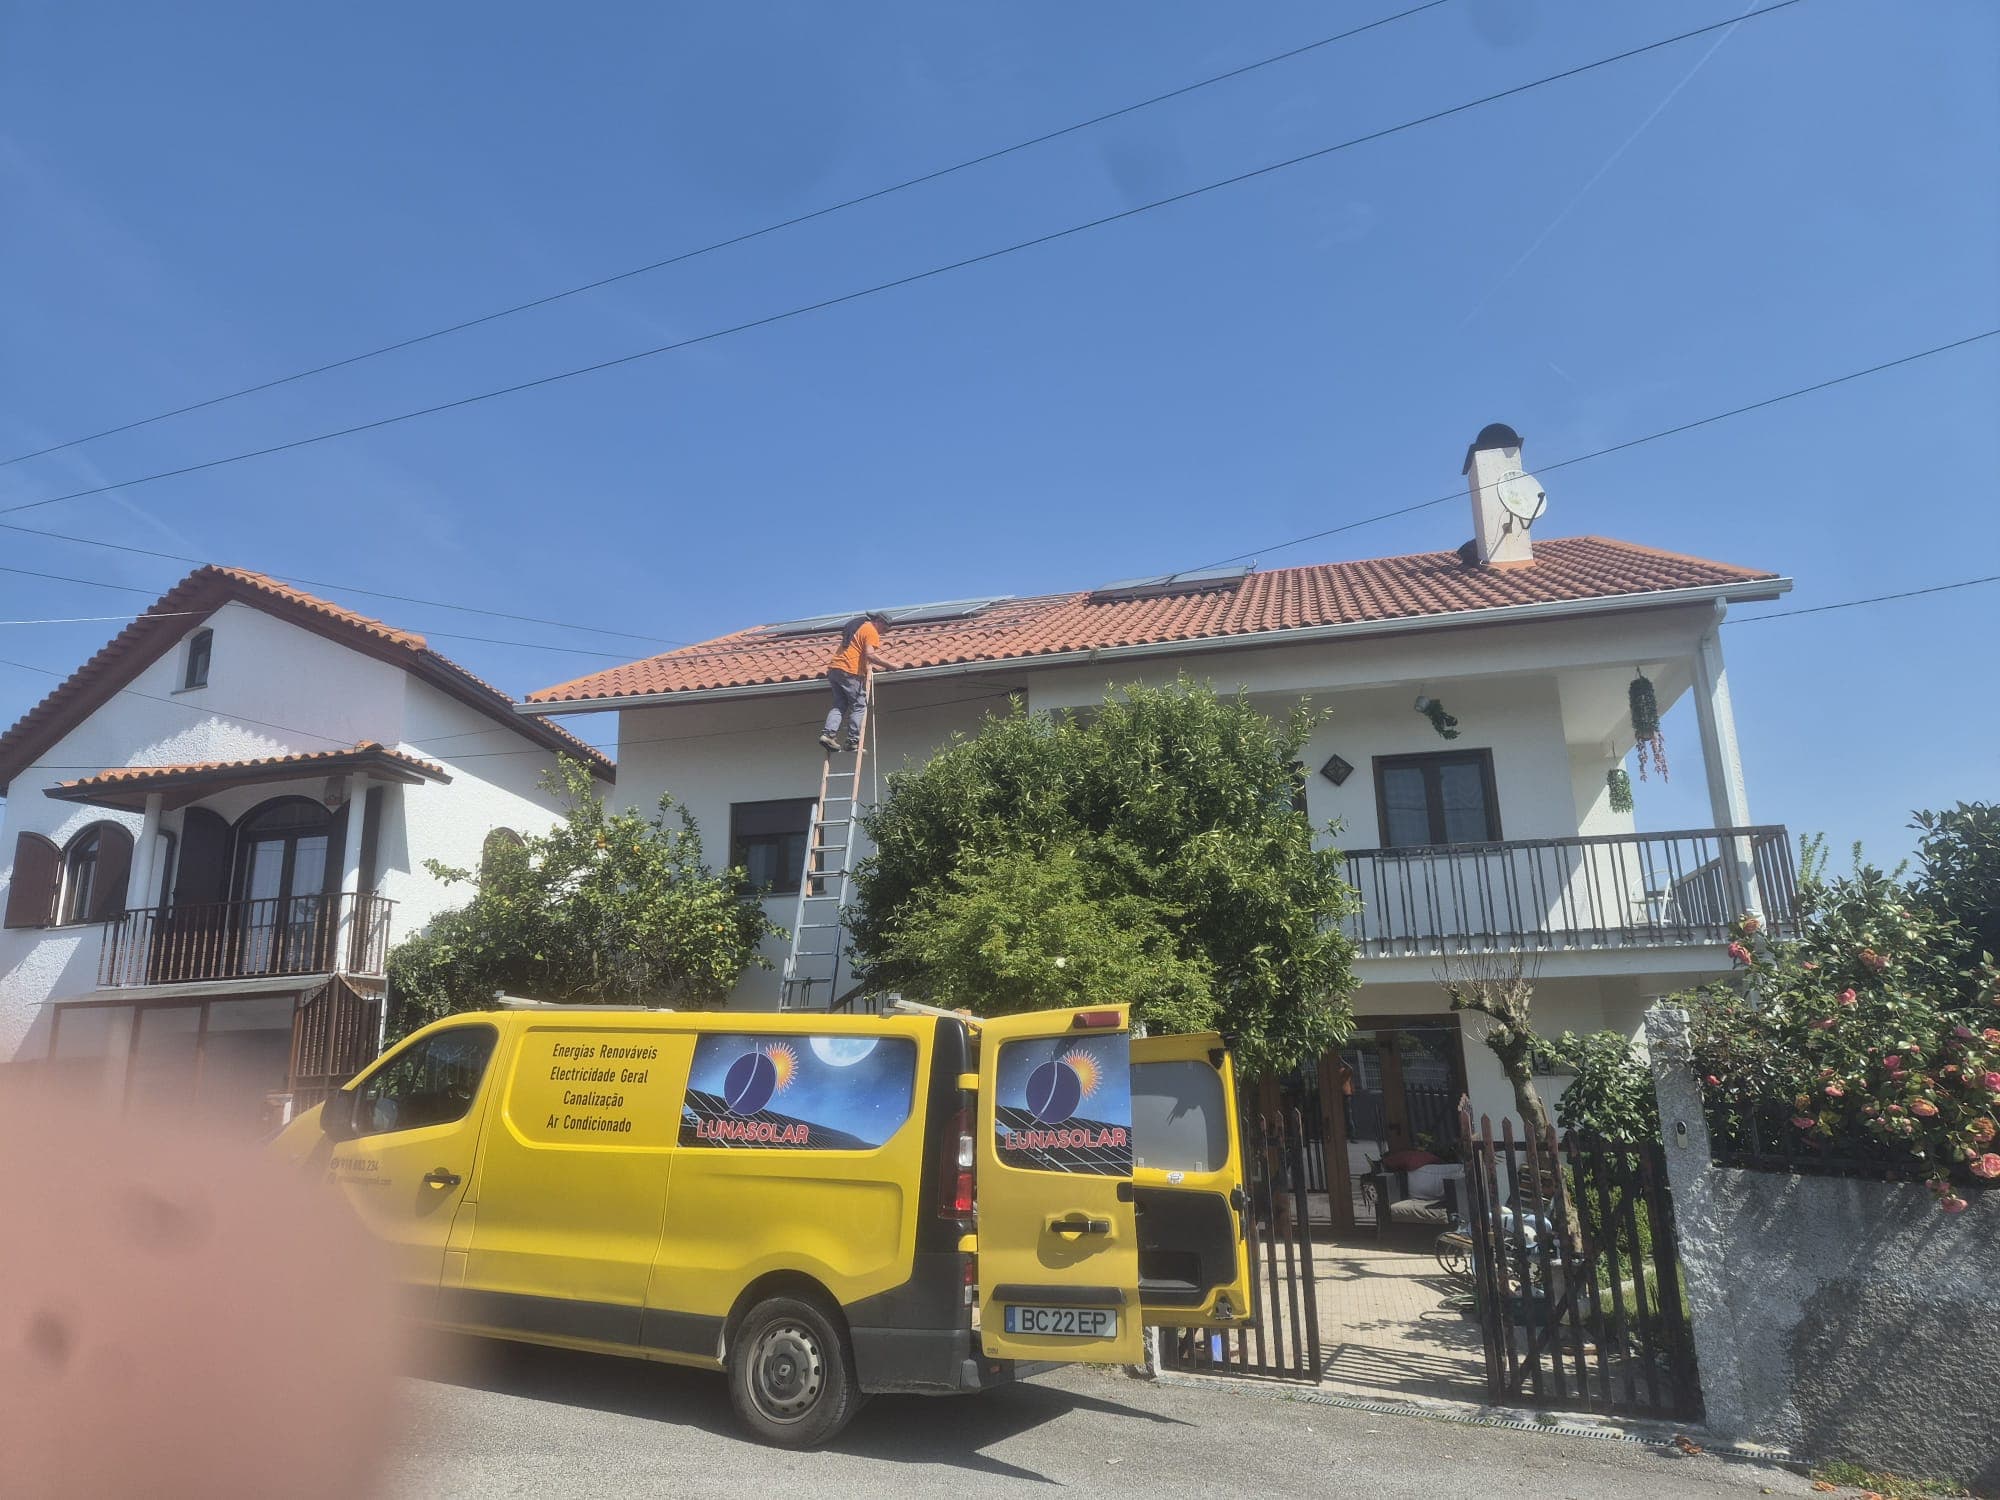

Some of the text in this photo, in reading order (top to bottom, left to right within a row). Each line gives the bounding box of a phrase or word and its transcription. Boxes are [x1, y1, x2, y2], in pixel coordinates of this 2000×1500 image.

[552, 1043, 658, 1060] Energias Renováveis
[550, 1066, 649, 1084] Electricidade Geral
[563, 1090, 624, 1110] Canalização
[546, 1114, 632, 1133] Ar Condicionado
[696, 1119, 809, 1144] LUNASOLAR
[1005, 1127, 1126, 1150] LUNASOLAR
